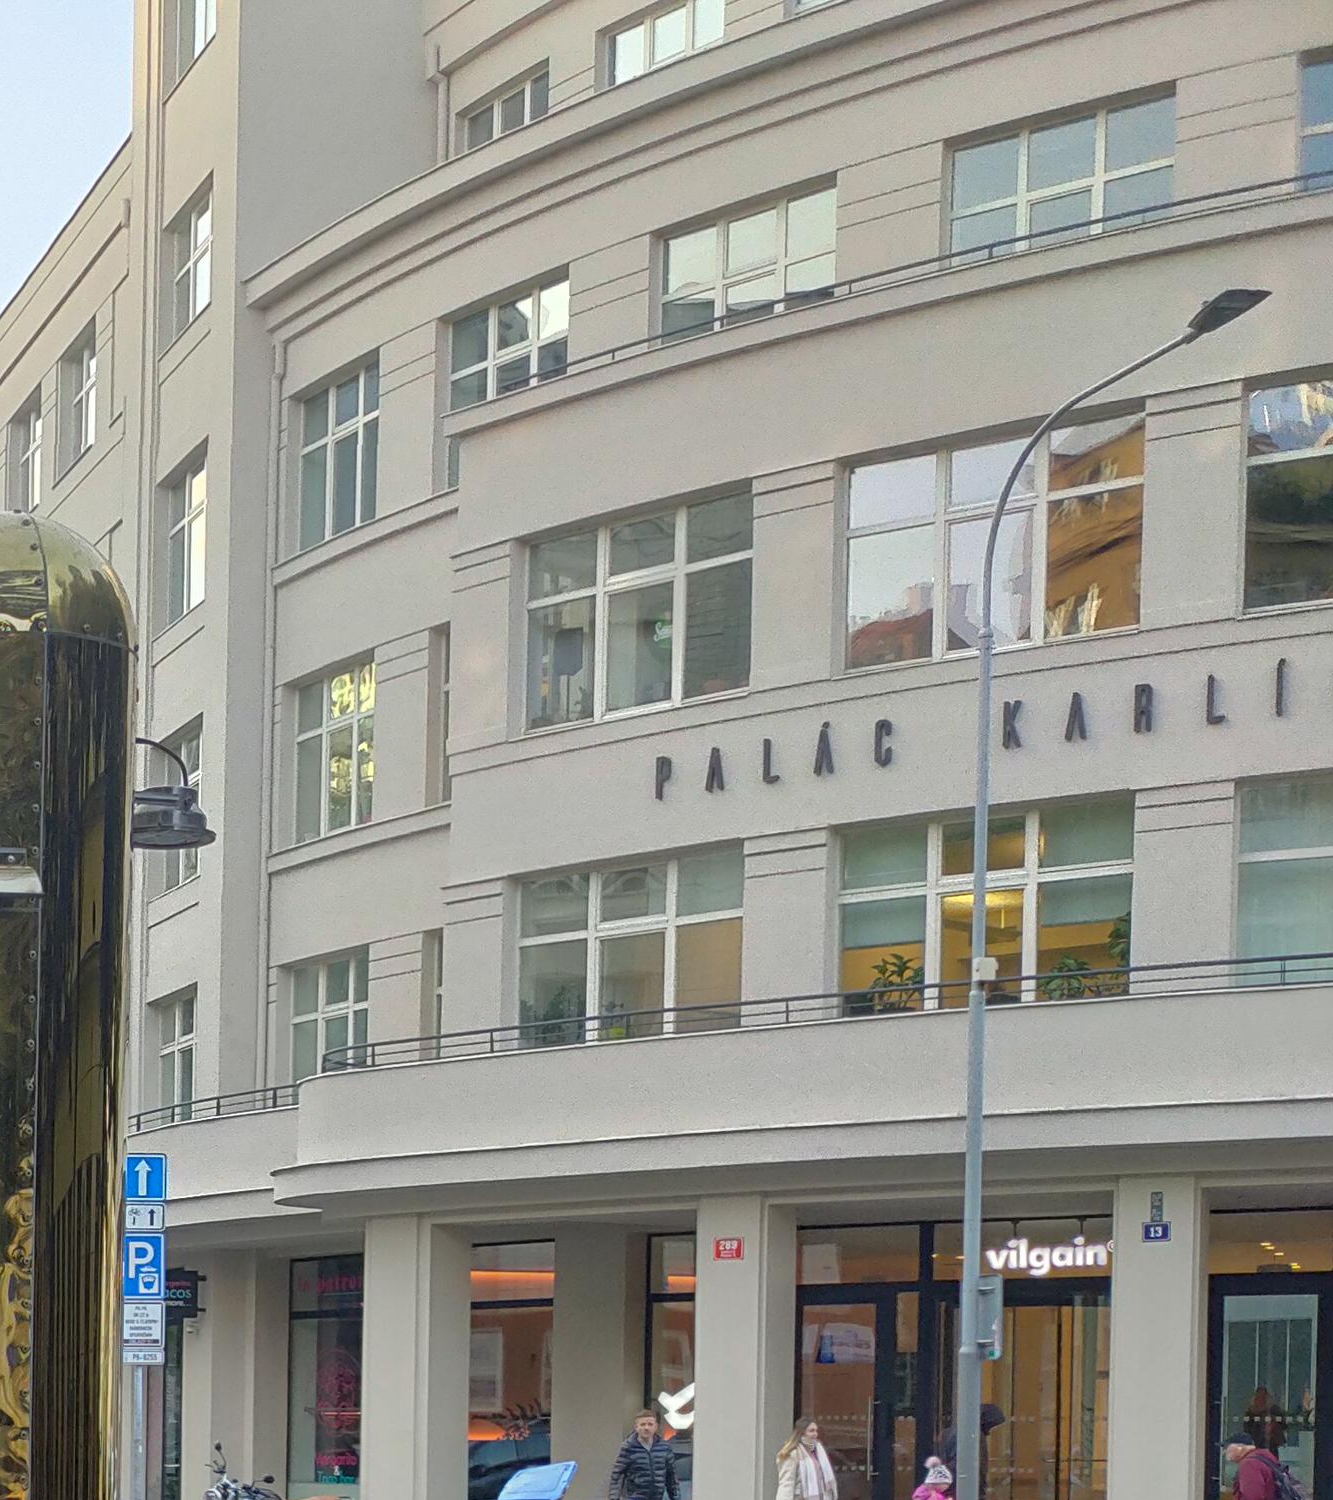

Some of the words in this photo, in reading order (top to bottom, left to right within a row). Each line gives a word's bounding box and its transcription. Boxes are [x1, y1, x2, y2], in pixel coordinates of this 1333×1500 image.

[655, 718, 893, 800] PALÁC
[1149, 1226, 1163, 1238] 13
[718, 1240, 738, 1250] 289
[128, 1241, 155, 1279] P
